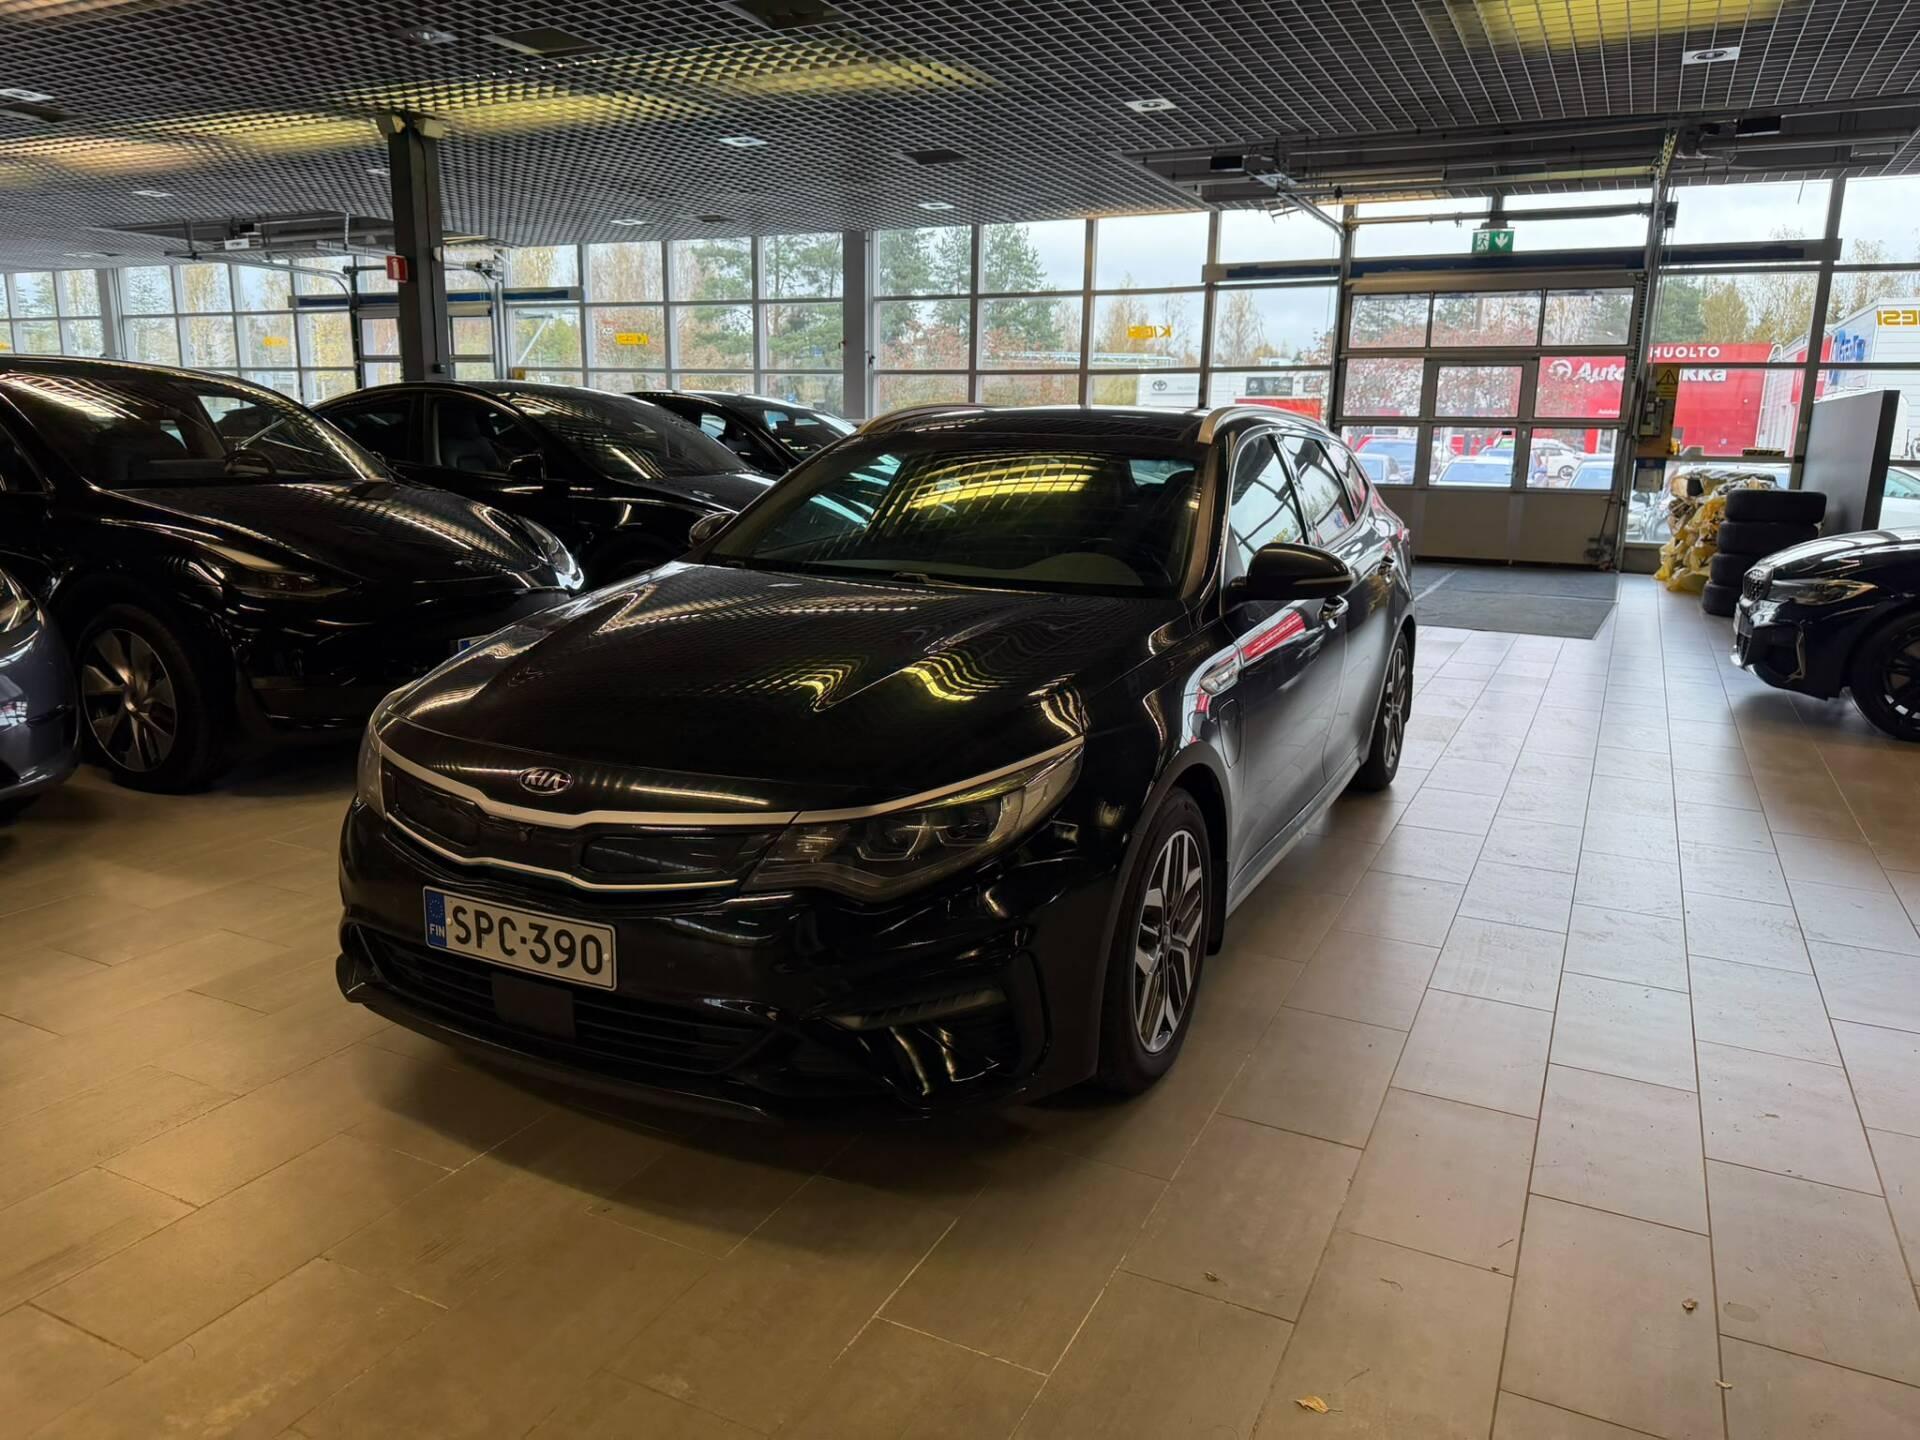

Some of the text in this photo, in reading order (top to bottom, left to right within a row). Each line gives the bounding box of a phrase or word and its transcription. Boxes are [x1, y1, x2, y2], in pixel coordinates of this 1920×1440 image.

[1649, 346, 1720, 358] HUOLTO
[525, 770, 561, 789] KIA
[429, 923, 446, 938] FIN
[452, 905, 603, 976] SPC-390
